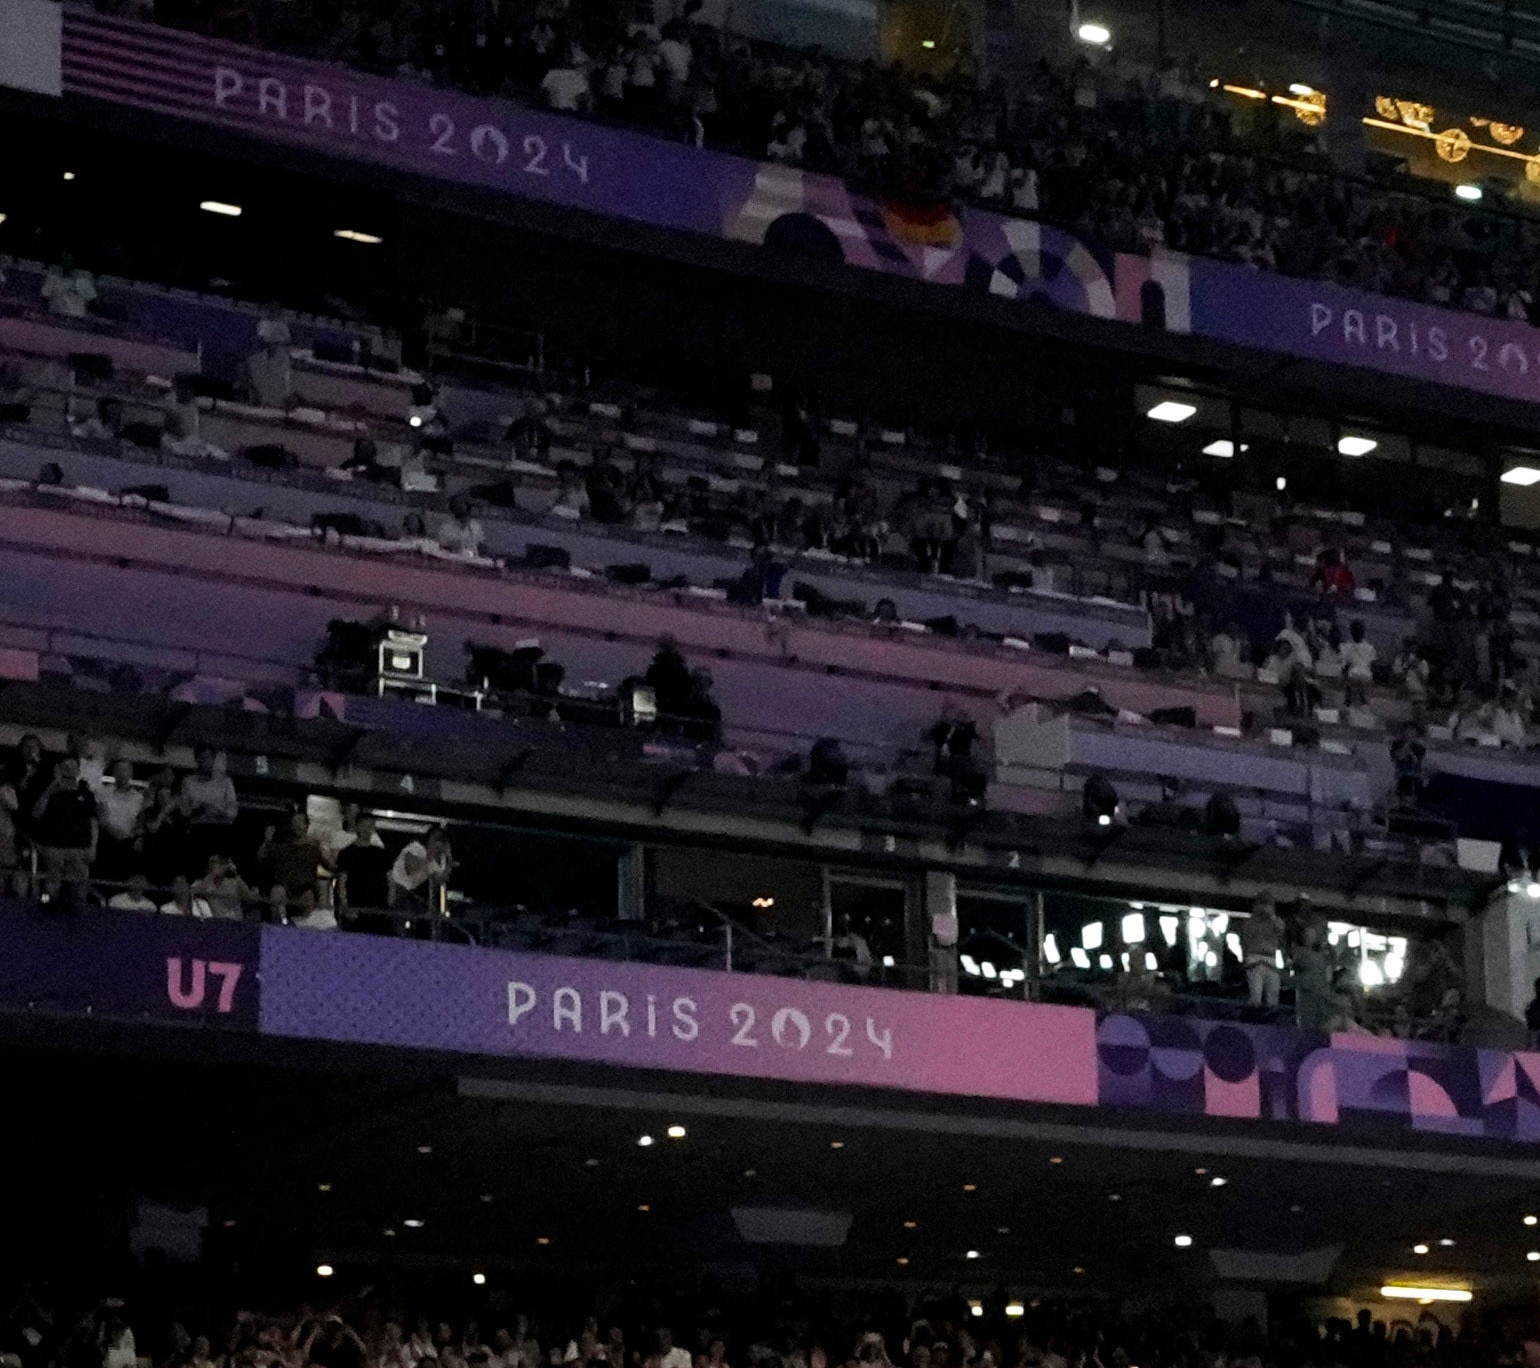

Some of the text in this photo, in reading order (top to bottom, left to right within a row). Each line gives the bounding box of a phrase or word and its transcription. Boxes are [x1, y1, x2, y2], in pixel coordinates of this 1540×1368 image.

[214, 66, 590, 184] PARIS 2024
[1311, 302, 1449, 362] PARIS
[167, 957, 243, 1014] U7
[507, 980, 893, 1060] PARIS 2024
